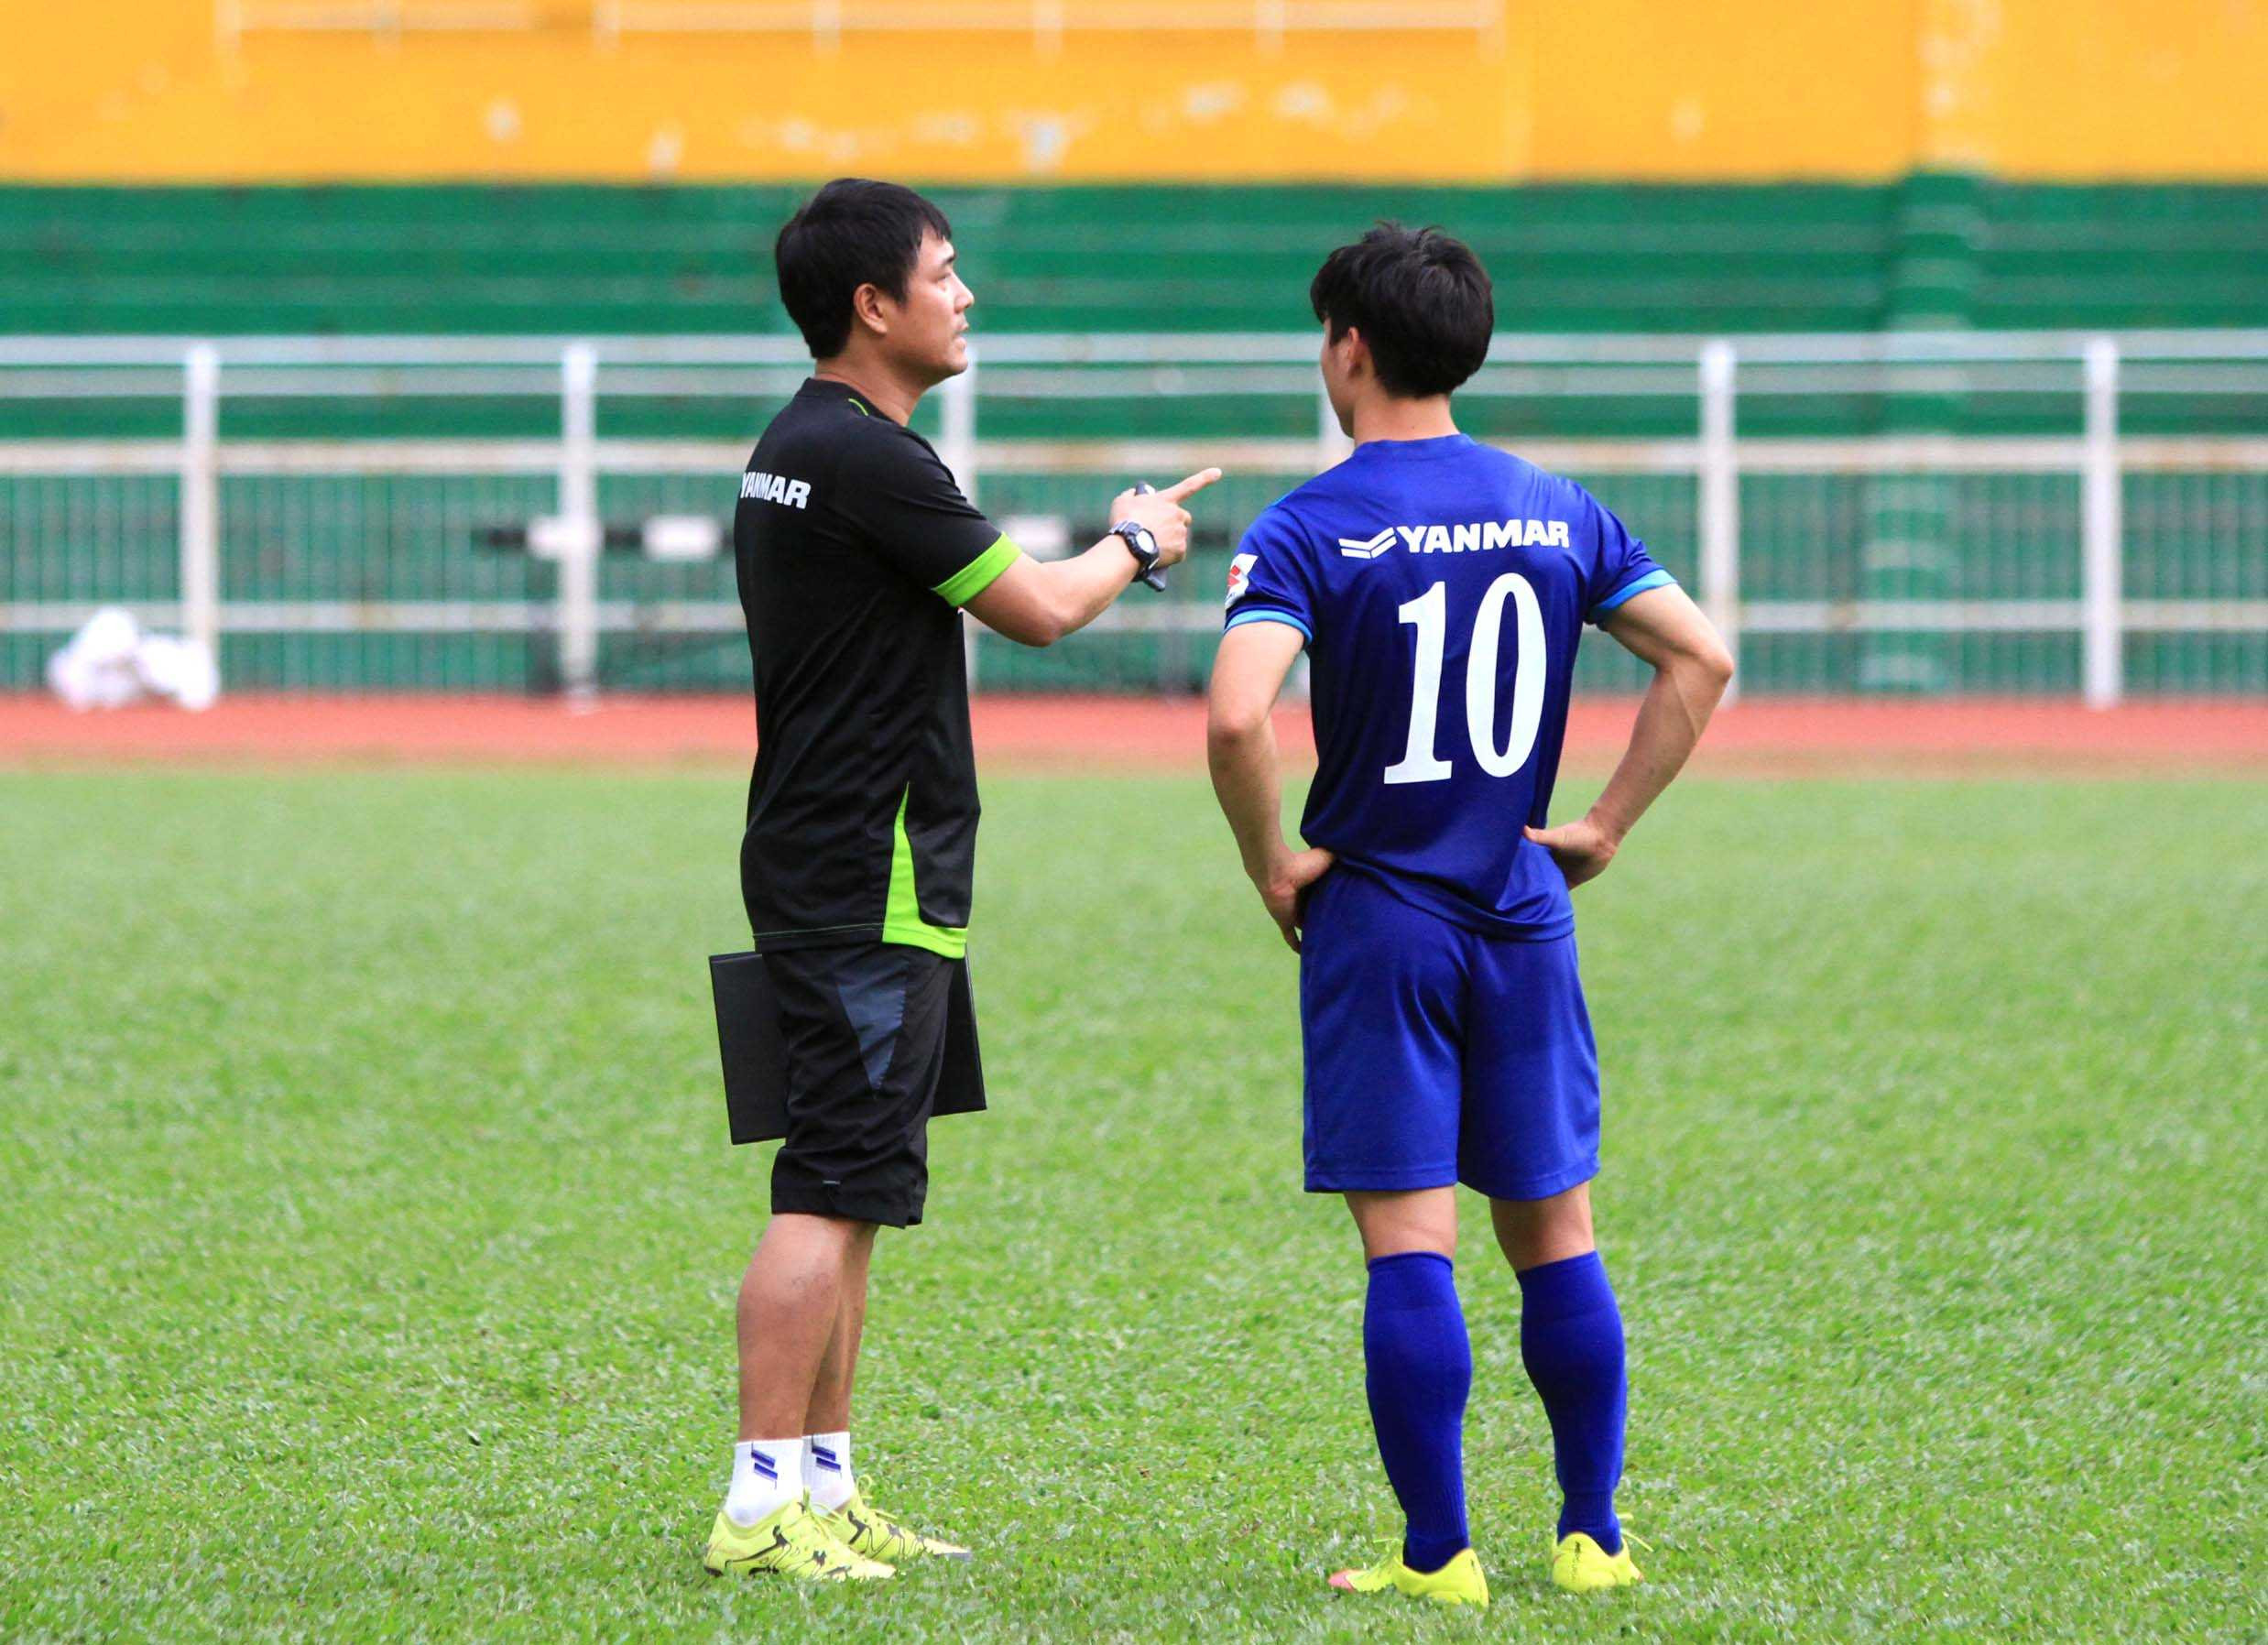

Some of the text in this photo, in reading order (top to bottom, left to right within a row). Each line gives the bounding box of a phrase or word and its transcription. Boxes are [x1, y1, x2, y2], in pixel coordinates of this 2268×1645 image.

[740, 472, 812, 509] YANMAR
[1396, 519, 1569, 553] YANMAR
[1384, 572, 1547, 784] 10
